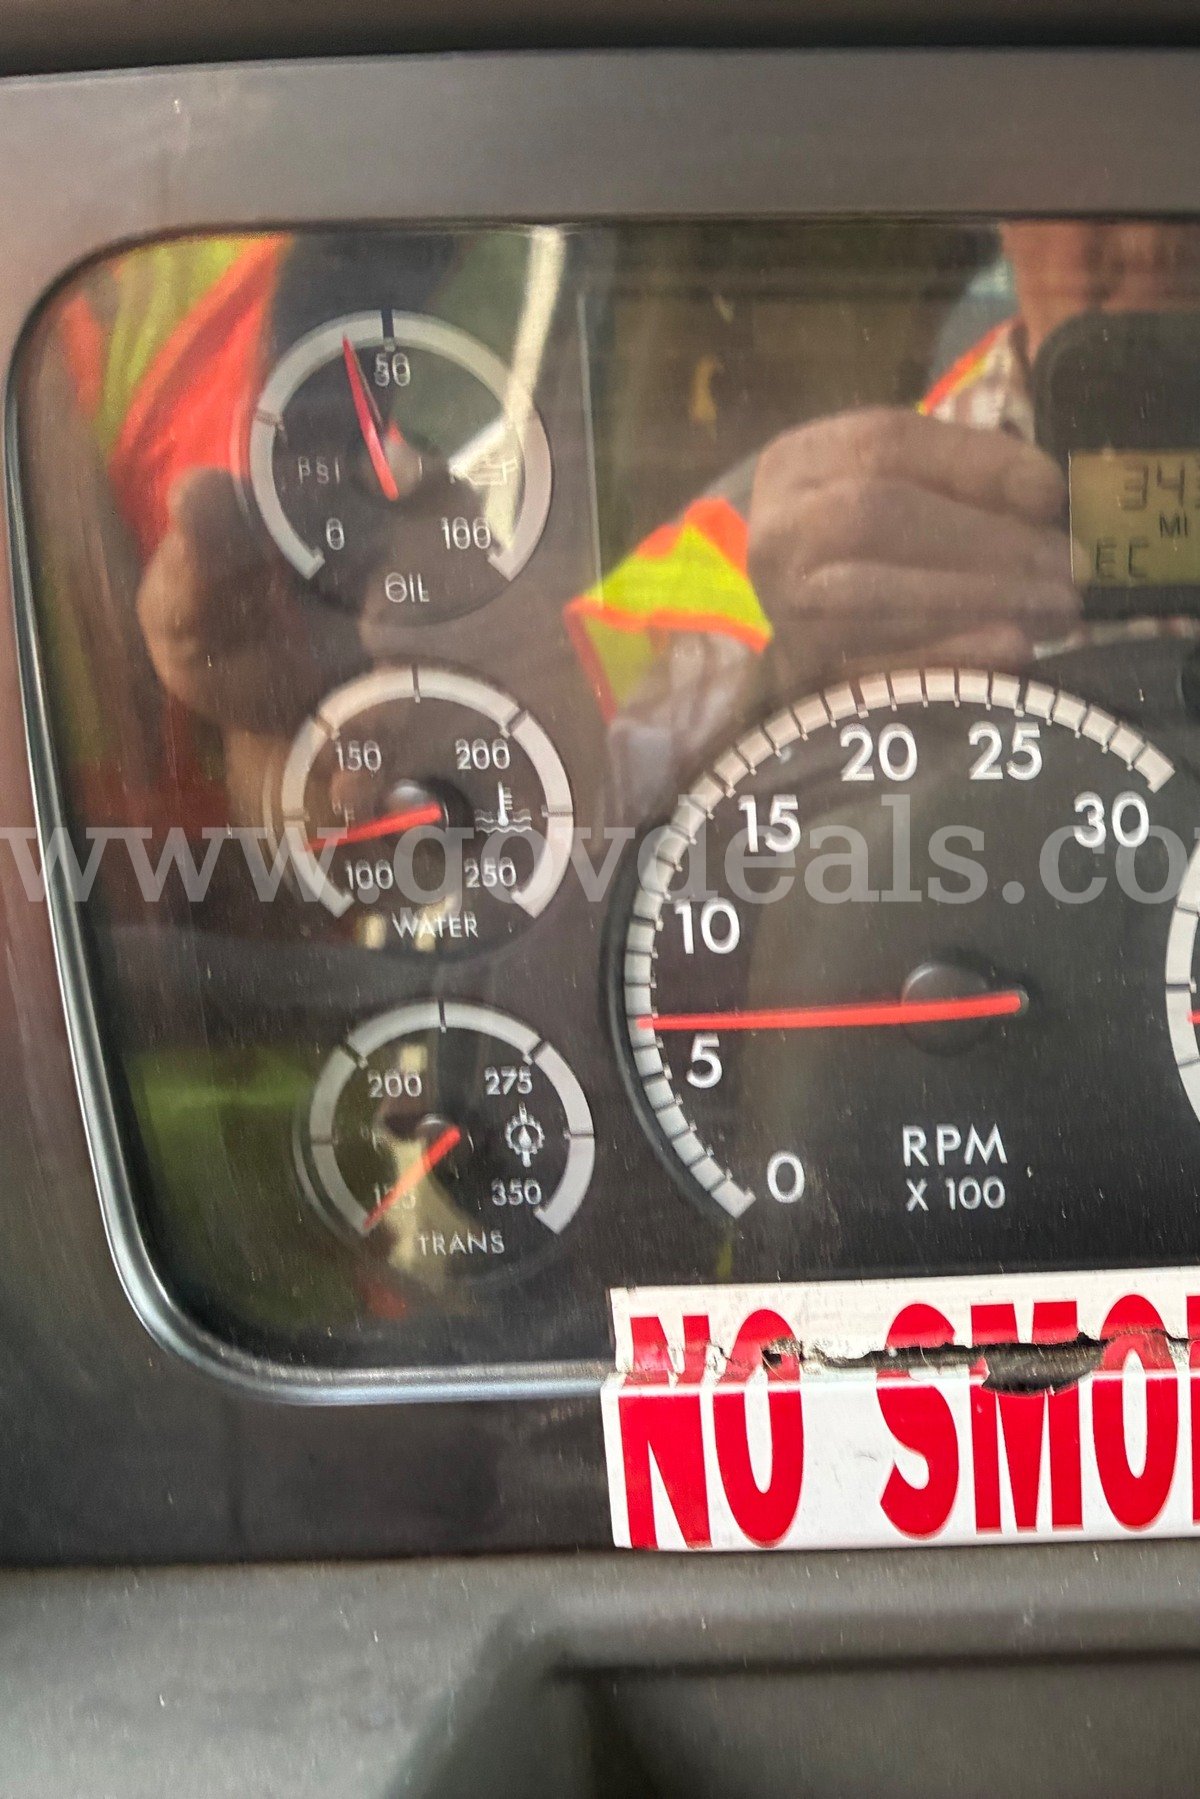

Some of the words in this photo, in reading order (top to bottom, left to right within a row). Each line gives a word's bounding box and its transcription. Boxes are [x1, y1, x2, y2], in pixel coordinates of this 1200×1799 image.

[374, 352, 411, 387] 50
[297, 456, 341, 484] PSI
[325, 518, 346, 550] 0
[440, 517, 491, 550] 100
[1159, 512, 1189, 538] MI
[1095, 538, 1150, 579] EC
[384, 572, 430, 602] OIL
[334, 740, 383, 772] 150
[454, 738, 510, 770] 200
[839, 723, 919, 782] 20
[967, 721, 1043, 780] 25
[738, 794, 801, 853] 15
[1073, 791, 1151, 849] 30
[344, 859, 394, 891] 100
[464, 857, 518, 890] 250
[391, 909, 478, 939] WATER
[675, 899, 741, 955] 10
[686, 1034, 723, 1089] 5
[367, 1067, 423, 1098] 200
[484, 1066, 533, 1096] 275
[902, 1124, 1008, 1167] RPM
[491, 1178, 542, 1206] 350
[766, 1151, 806, 1203] 0
[905, 1181, 930, 1211] X
[946, 1178, 1006, 1210] 100
[419, 1230, 505, 1256] TRANS
[617, 1308, 804, 1550] NO
